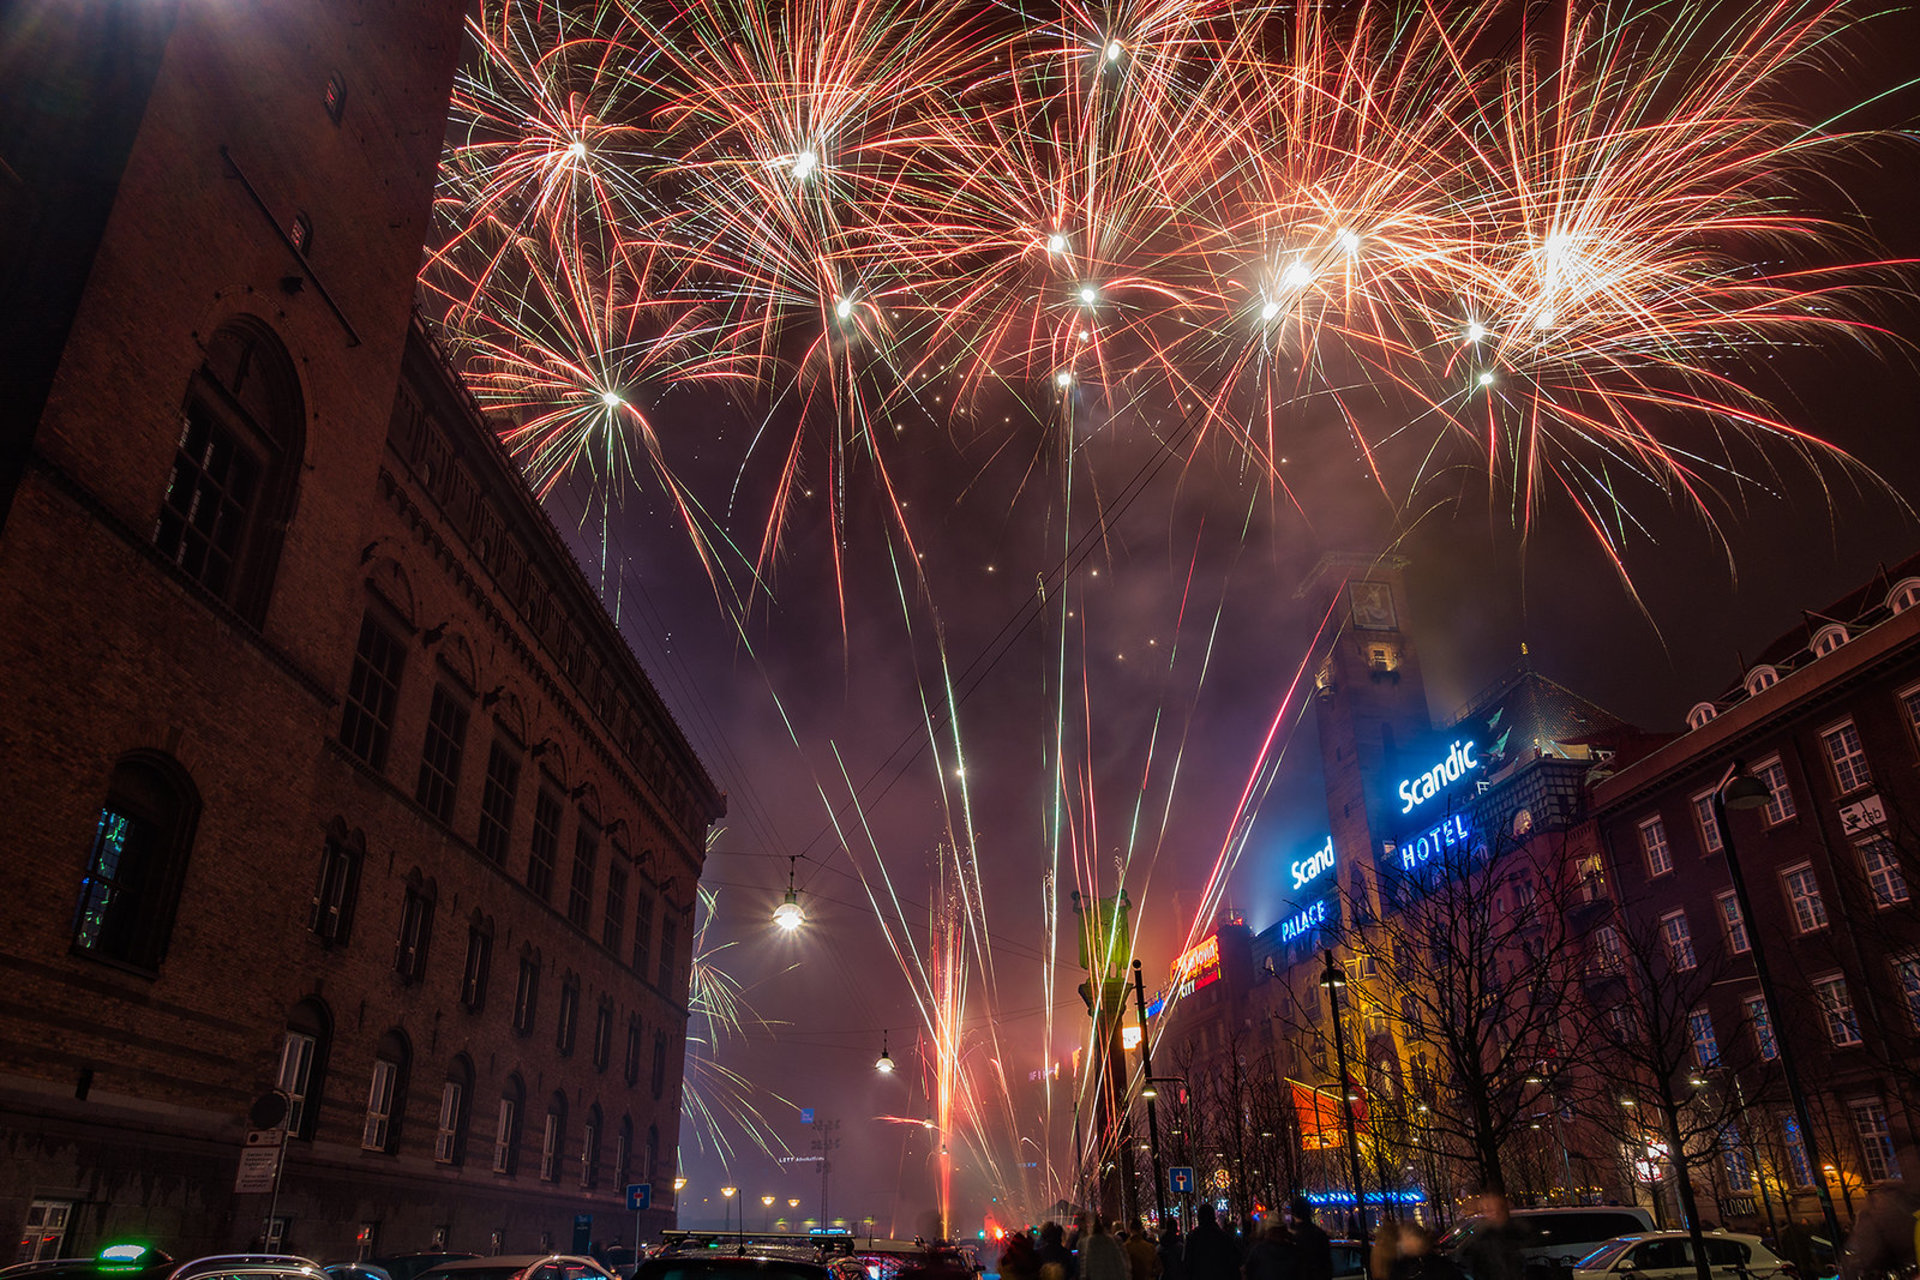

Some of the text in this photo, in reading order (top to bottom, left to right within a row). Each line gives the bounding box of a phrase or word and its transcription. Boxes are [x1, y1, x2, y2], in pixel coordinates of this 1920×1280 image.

[1399, 740, 1478, 814] Scandic
[1291, 835, 1335, 890] Scand
[1402, 815, 1468, 871] HOTEL
[1281, 900, 1326, 942] PALACE
